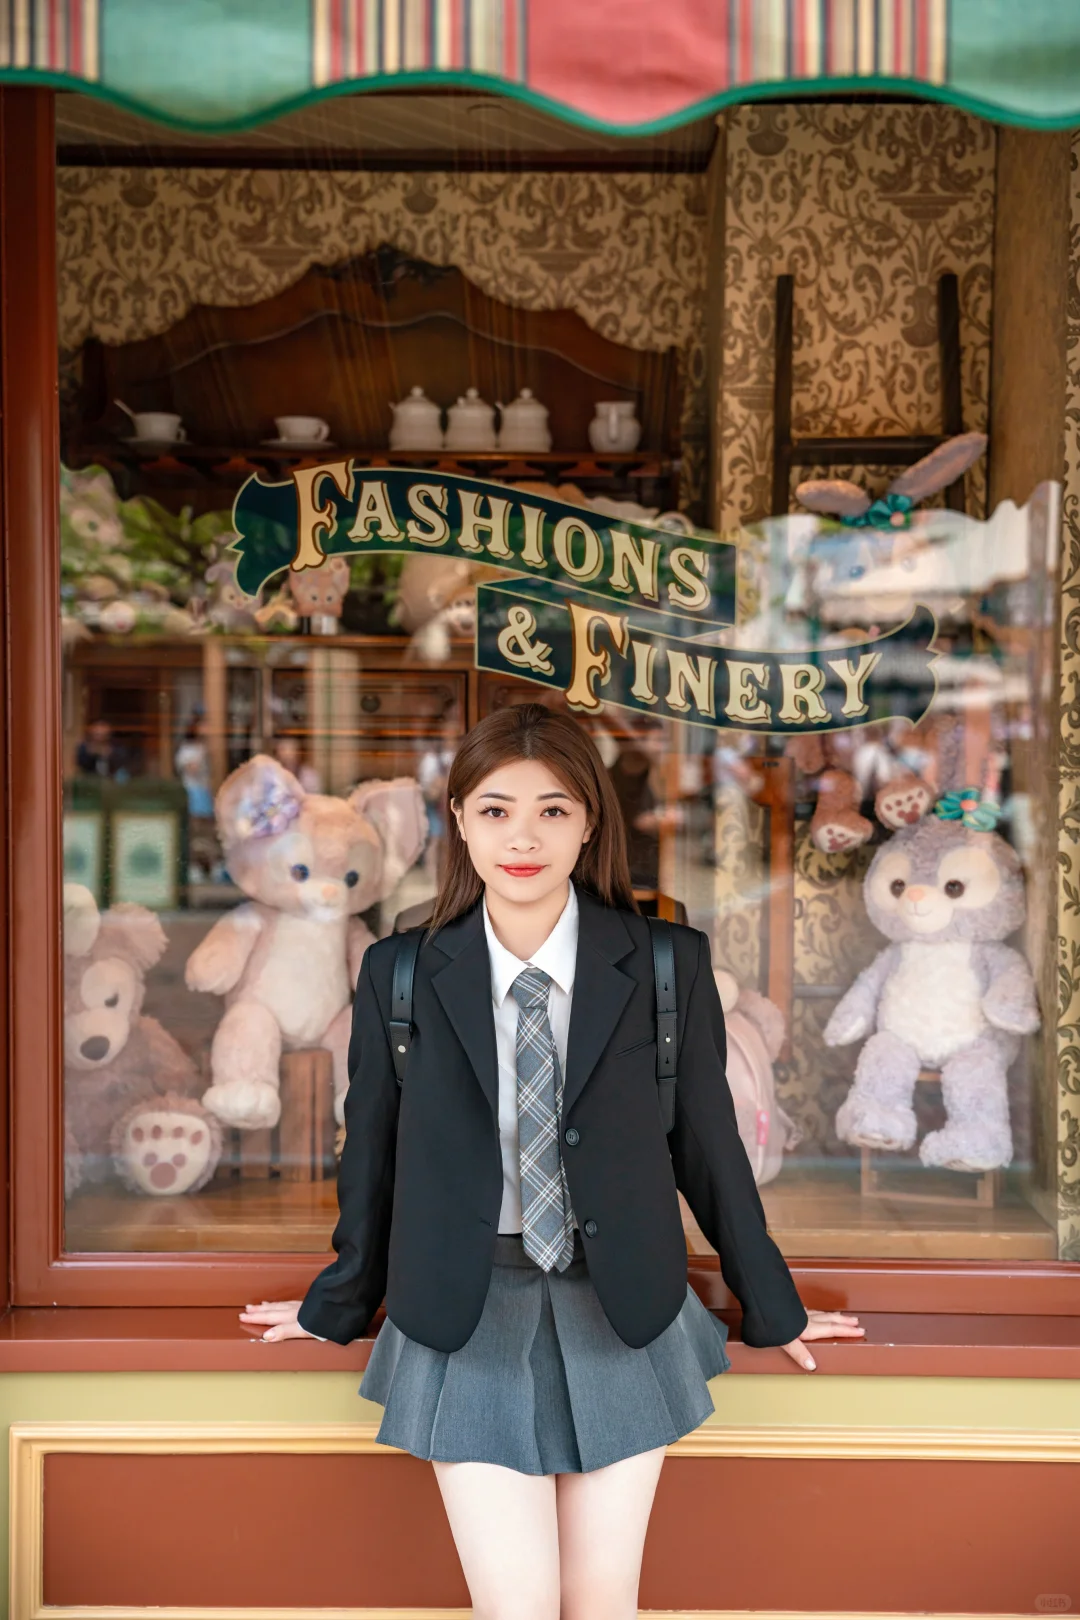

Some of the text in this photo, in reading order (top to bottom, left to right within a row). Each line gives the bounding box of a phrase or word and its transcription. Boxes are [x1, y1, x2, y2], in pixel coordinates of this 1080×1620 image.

[291, 458, 711, 611] FASHIONS
[497, 601, 883, 725] & FINERY
